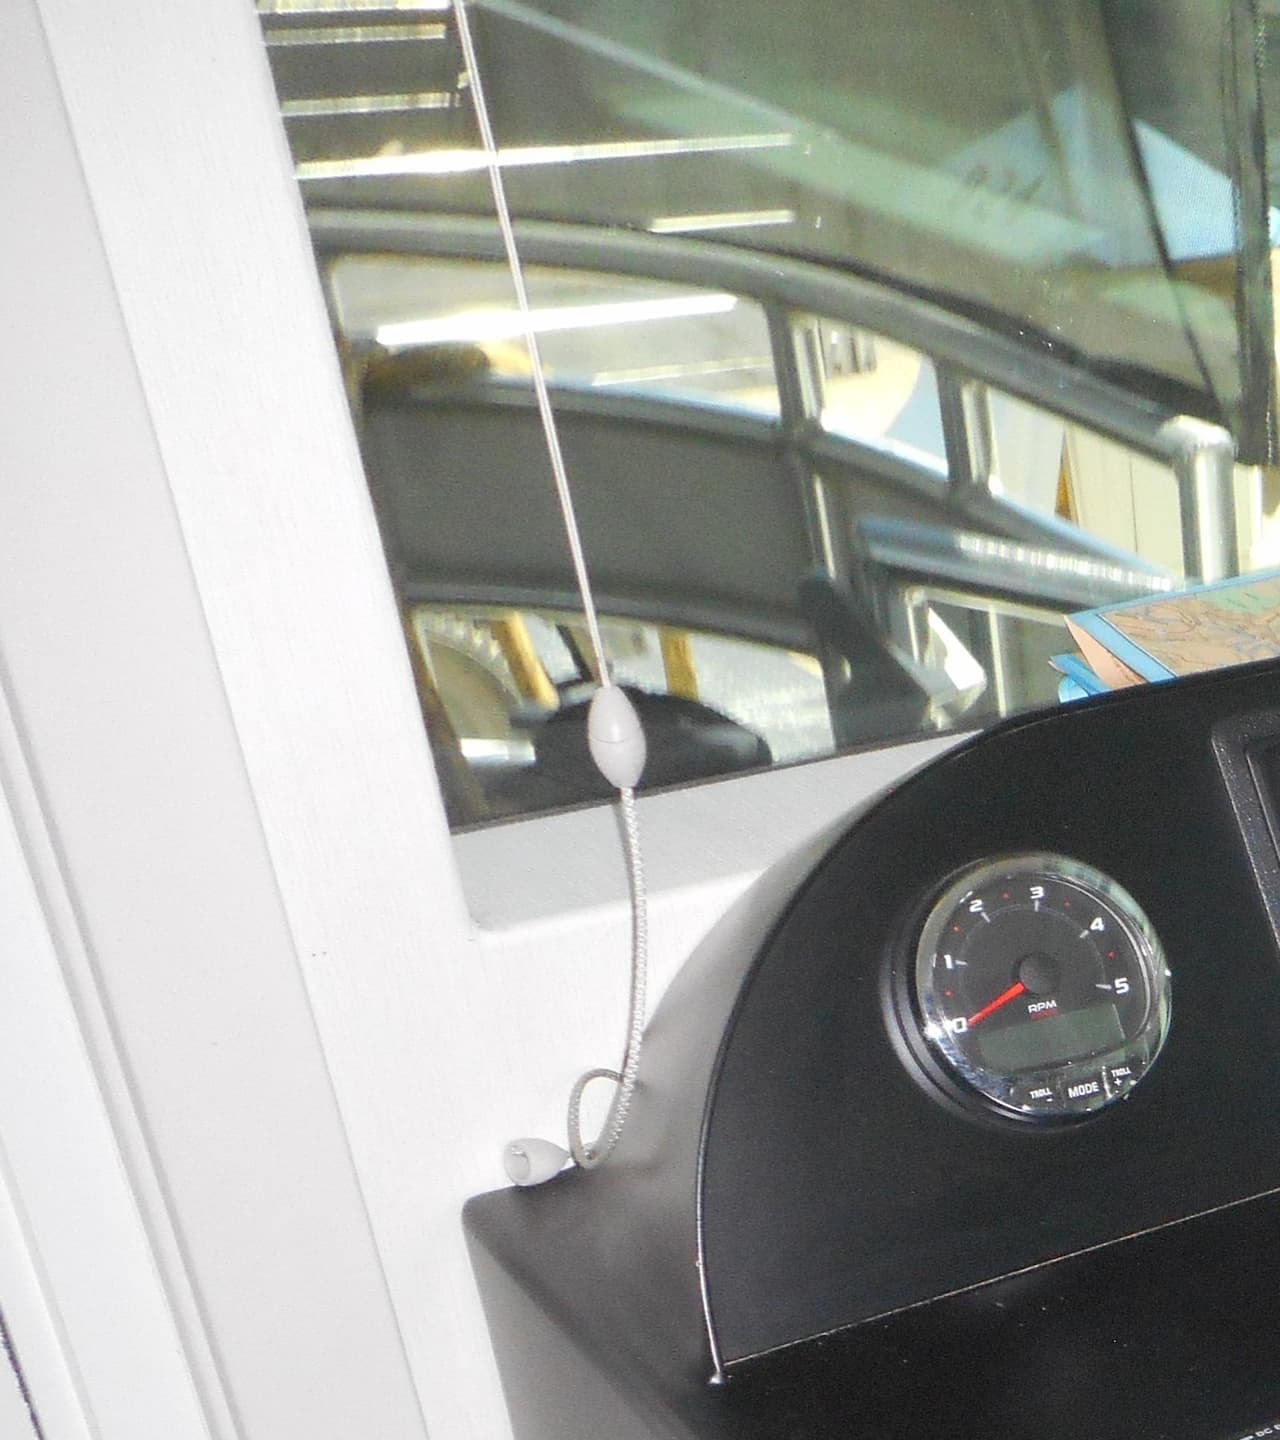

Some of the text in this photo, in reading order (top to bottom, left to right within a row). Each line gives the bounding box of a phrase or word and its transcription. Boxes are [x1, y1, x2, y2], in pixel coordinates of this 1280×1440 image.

[1030, 886, 1044, 898] 3
[969, 900, 983, 912] 2
[1090, 918, 1105, 931] 4
[944, 954, 953, 969] 1
[1114, 977, 1129, 993] 5
[1027, 1000, 1057, 1014] RPM
[952, 1018, 967, 1034] 0
[1030, 1087, 1053, 1099] TROLL
[1068, 1081, 1100, 1098] MODE
[1256, 1427, 1273, 1438] DC
